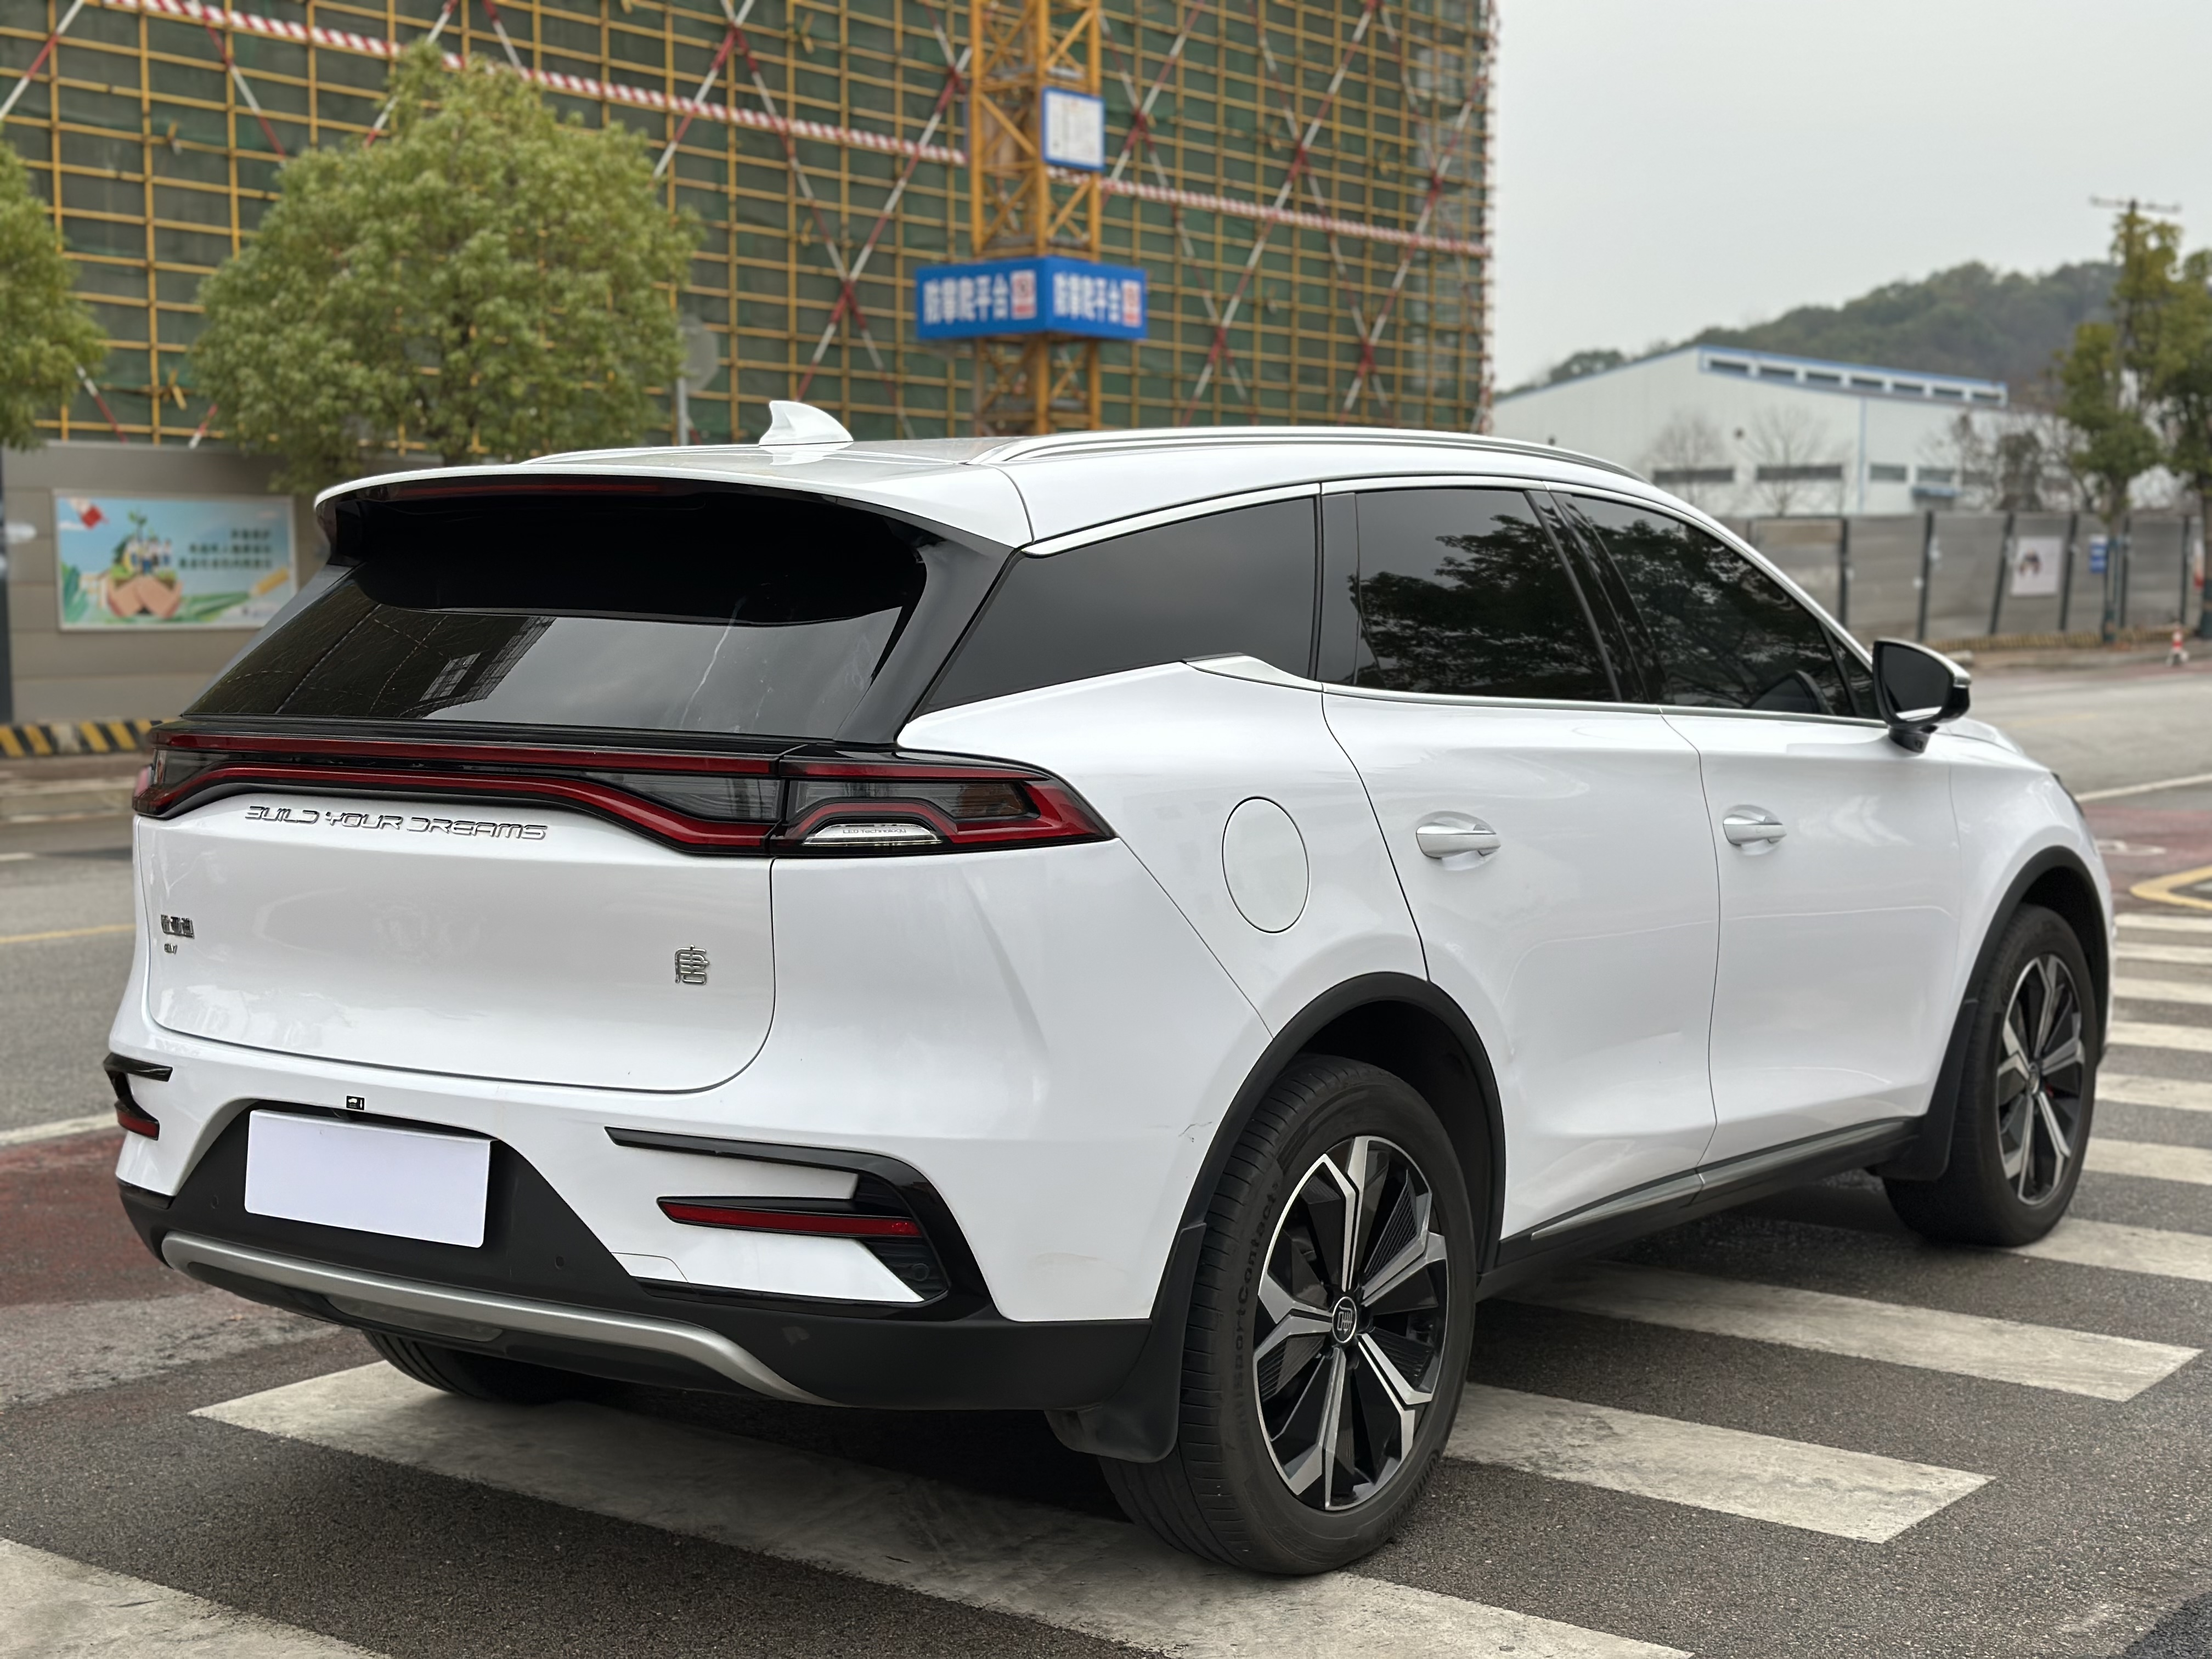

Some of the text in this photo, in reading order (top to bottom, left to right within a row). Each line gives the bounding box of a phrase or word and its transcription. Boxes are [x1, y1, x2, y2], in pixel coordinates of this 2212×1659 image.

[245, 805, 548, 840] BUILD YOUR DREAMS
